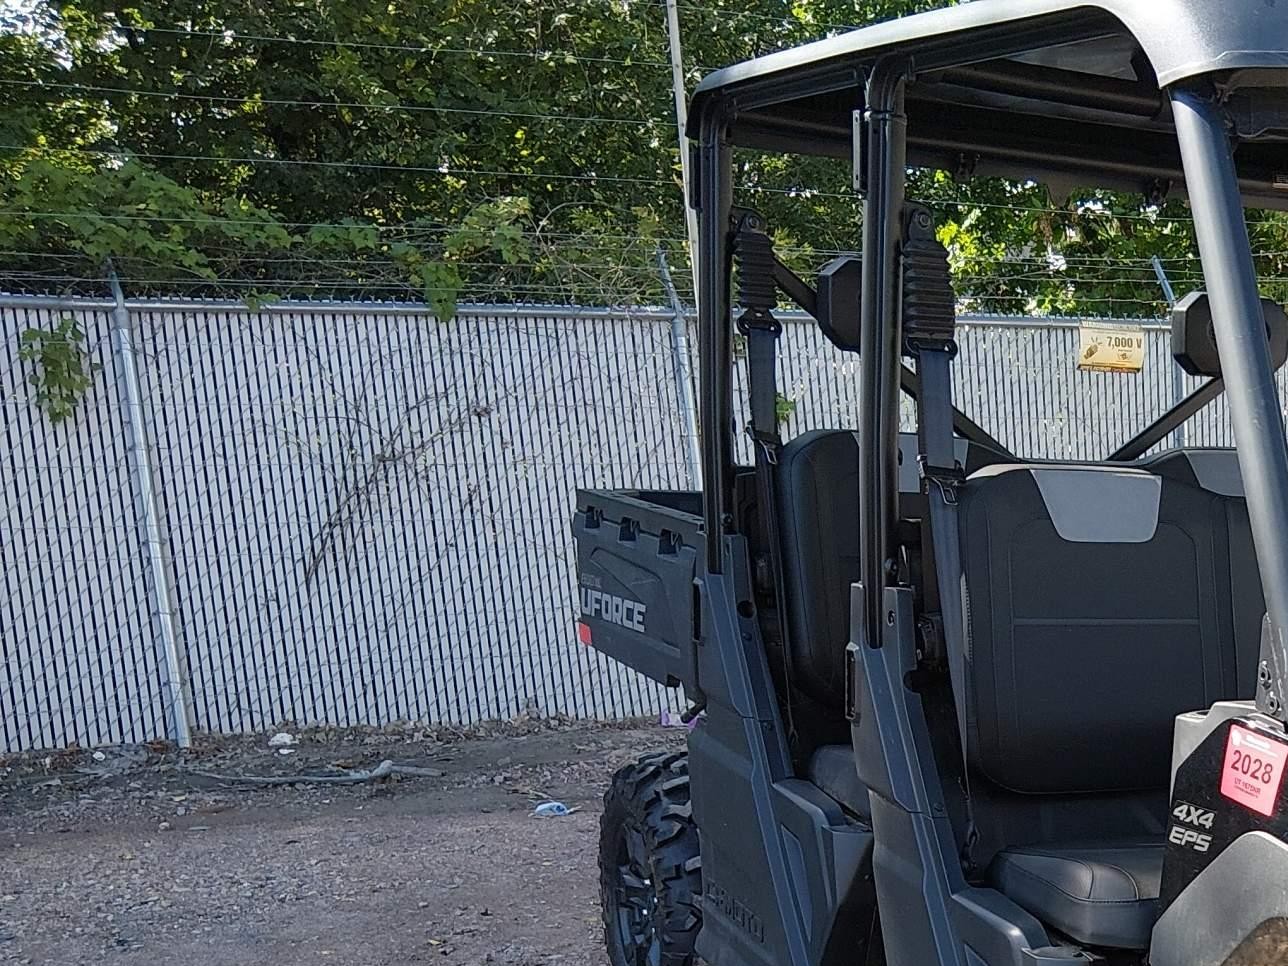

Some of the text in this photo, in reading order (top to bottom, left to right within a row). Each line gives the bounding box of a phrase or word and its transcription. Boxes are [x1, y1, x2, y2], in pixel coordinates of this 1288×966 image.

[1107, 336, 1142, 349] 7,000 V
[581, 587, 646, 633] UFORCE
[1231, 750, 1273, 784] 2028
[1173, 804, 1215, 829] 4X4
[1169, 826, 1212, 851] EPS
